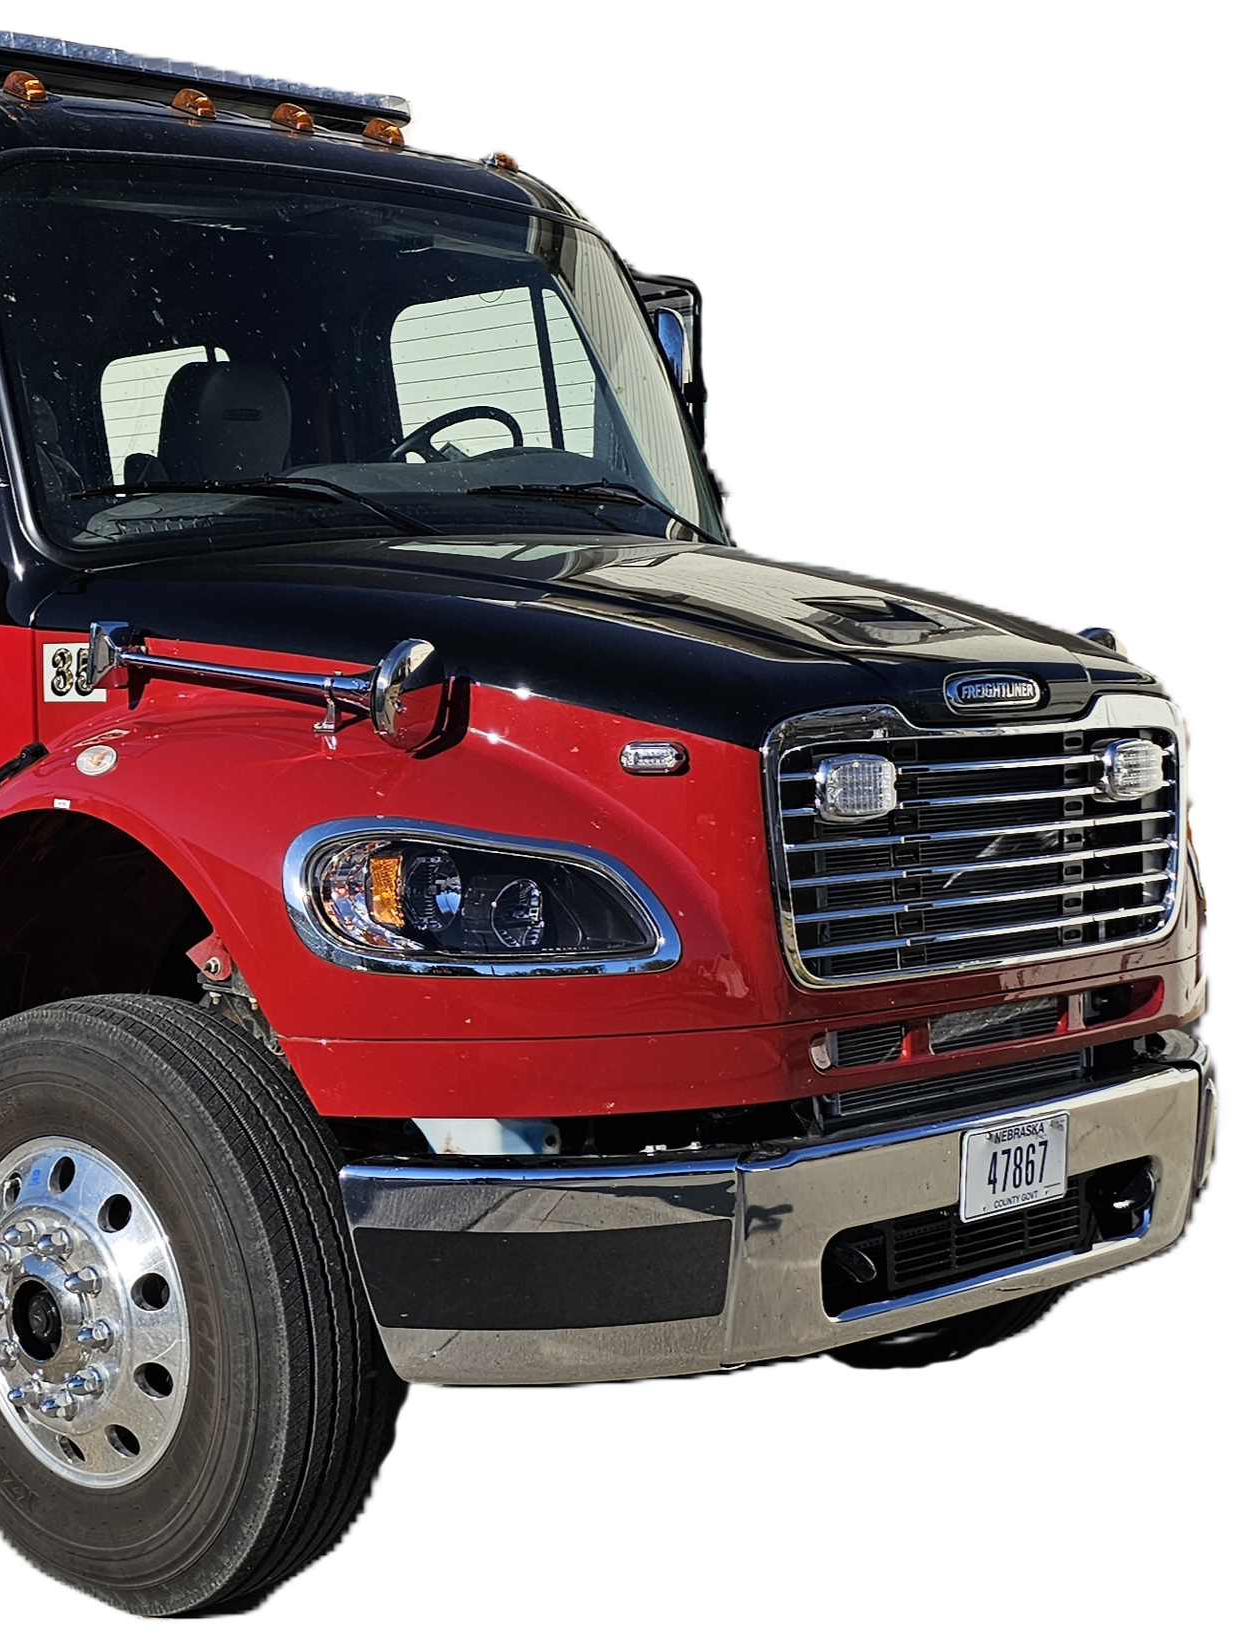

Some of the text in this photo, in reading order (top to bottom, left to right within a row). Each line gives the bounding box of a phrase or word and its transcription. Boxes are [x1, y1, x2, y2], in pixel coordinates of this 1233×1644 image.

[961, 682, 1034, 699] FREIGHTLINER
[994, 1122, 1045, 1144] NEBRASKA
[987, 1140, 1048, 1194] 47867
[994, 1190, 1039, 1209] COUNTY GOVT
